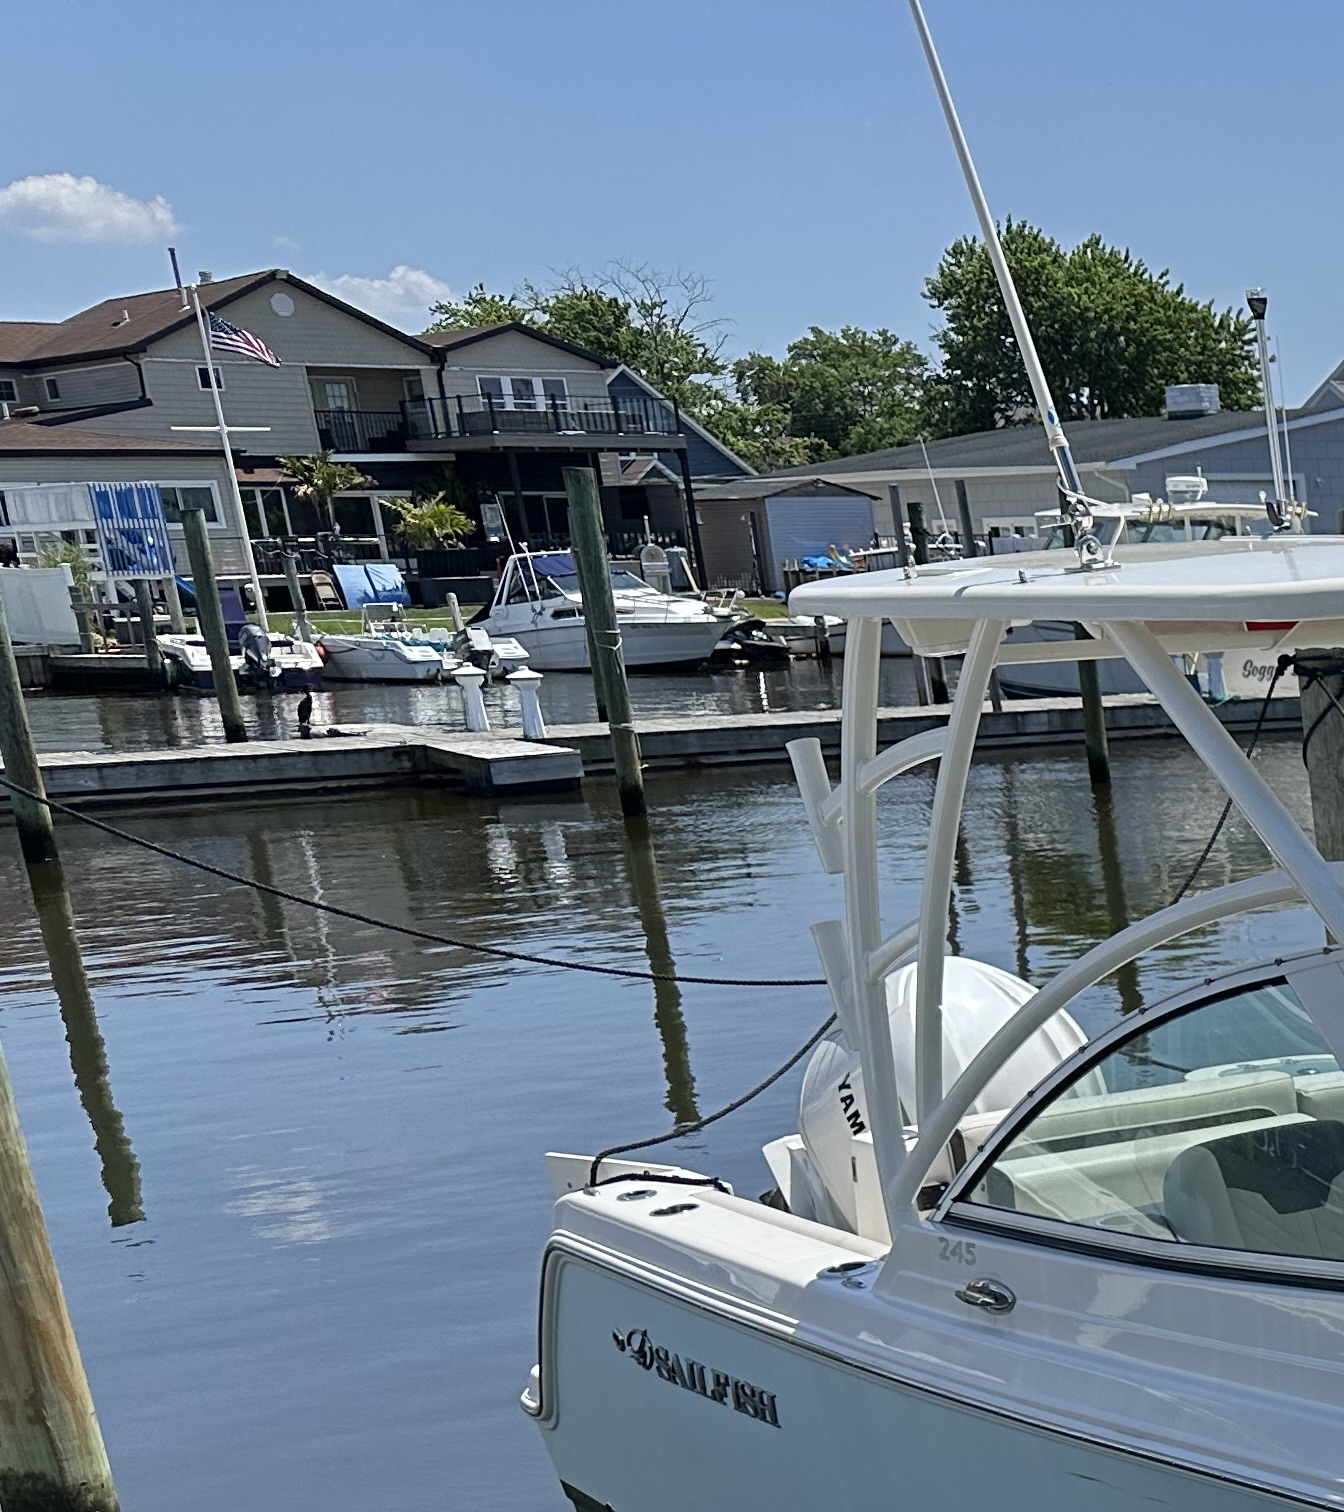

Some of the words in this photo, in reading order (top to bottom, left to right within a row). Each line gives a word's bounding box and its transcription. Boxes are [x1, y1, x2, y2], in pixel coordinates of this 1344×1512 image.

[1242, 659, 1278, 682] Sogg
[838, 1071, 867, 1136] YAM
[938, 1236, 977, 1266] 245
[655, 1345, 782, 1429] SAILFISH
